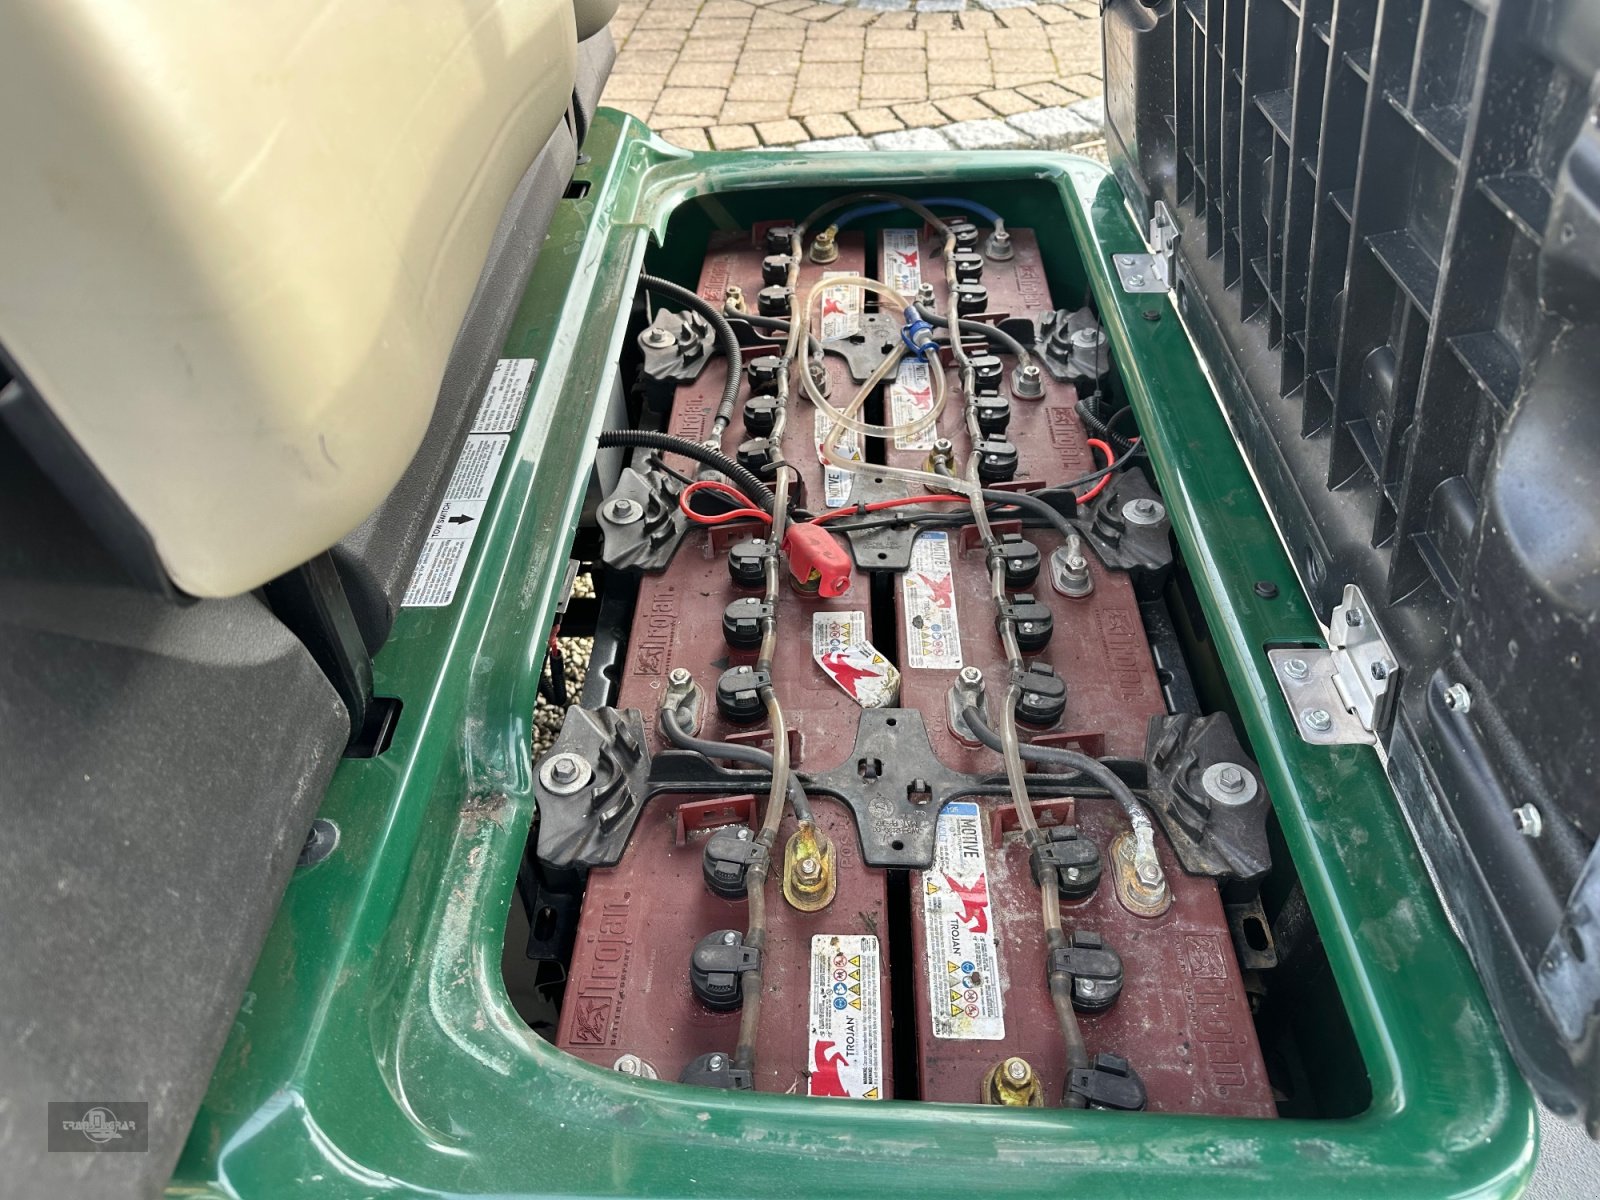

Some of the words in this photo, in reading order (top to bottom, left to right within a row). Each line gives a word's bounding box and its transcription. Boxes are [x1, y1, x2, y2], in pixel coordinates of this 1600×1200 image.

[829, 473, 840, 498] MOTIVE
[430, 525, 443, 538] TOW
[437, 502, 450, 524] SWITCH
[638, 593, 677, 648] Trojan
[961, 818, 979, 858] MOTIVE
[577, 900, 632, 996] Trojan
[950, 918, 961, 954] TROJAN
[846, 1017, 856, 1057] TROJAN
[1195, 979, 1248, 1087] Trojan
